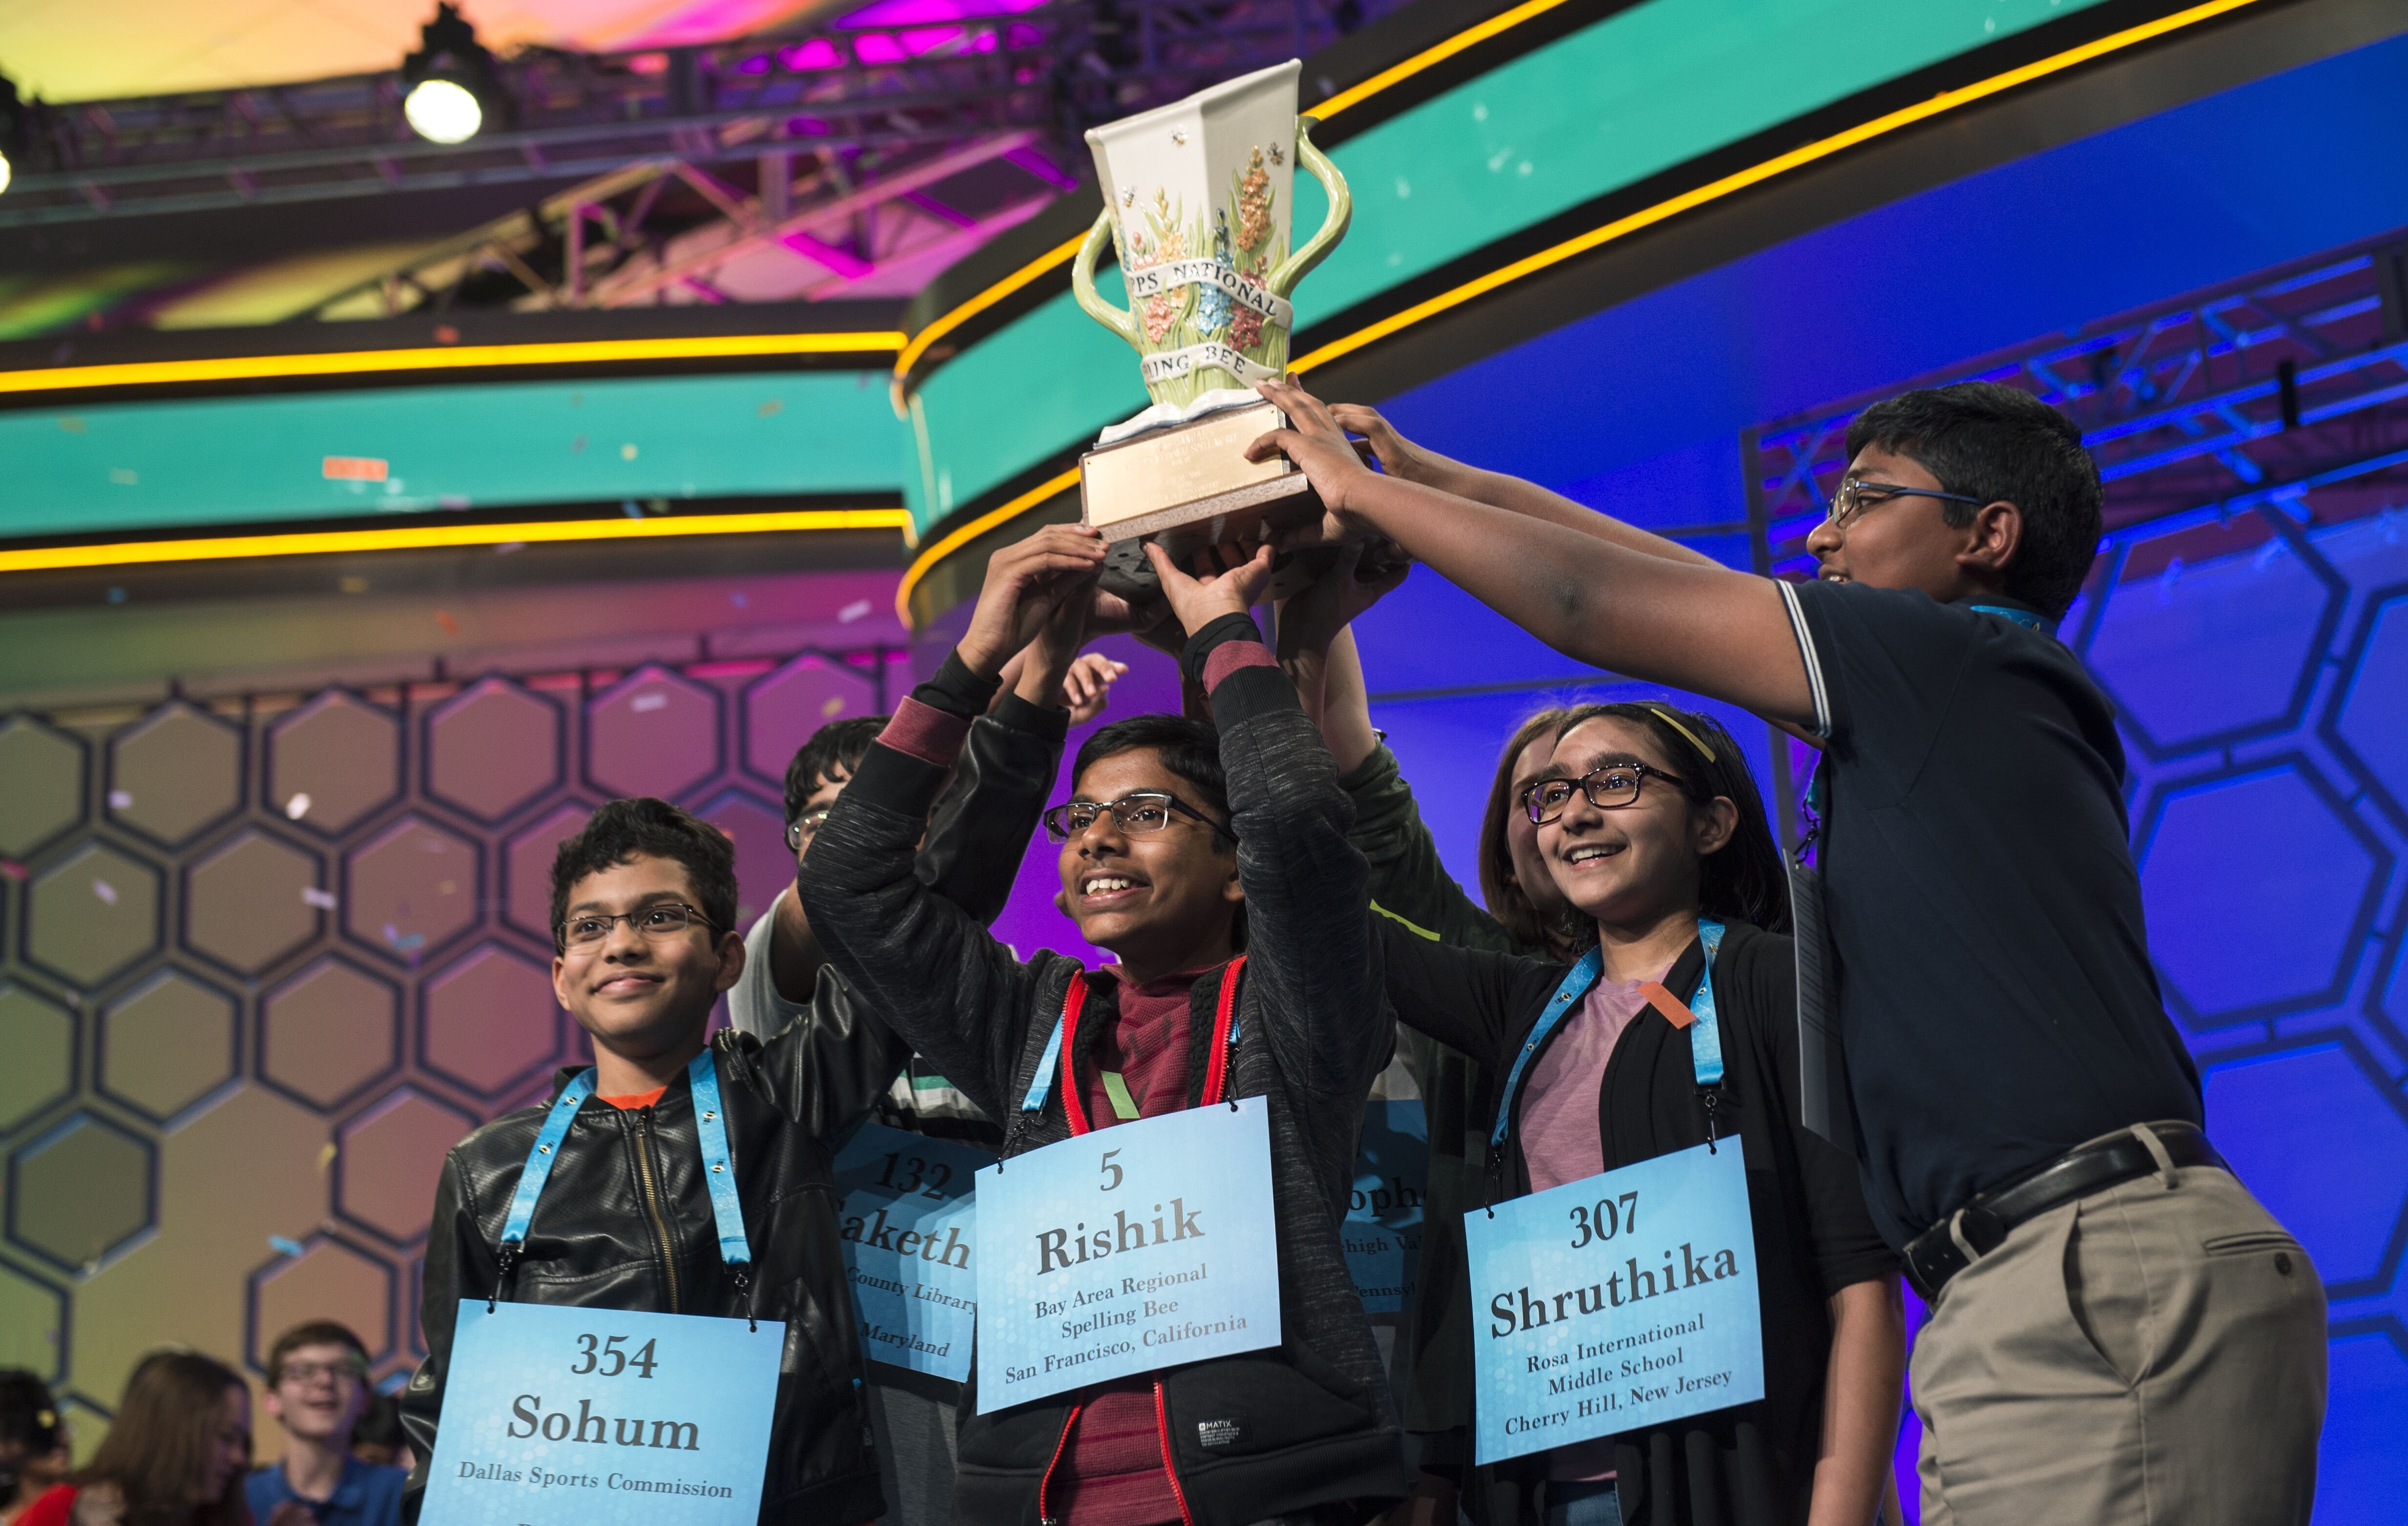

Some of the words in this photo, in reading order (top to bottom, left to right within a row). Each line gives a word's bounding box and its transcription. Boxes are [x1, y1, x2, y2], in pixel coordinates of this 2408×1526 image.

[1173, 263, 1276, 316] NATIONAL
[1205, 346, 1246, 374] BEE
[874, 1153, 952, 1200] 132
[1100, 1148, 1123, 1191] 5
[1350, 1176, 1426, 1217] oph
[1570, 1191, 1638, 1248] 307
[837, 1198, 970, 1270] aketh
[1036, 1198, 1205, 1275] Rishik
[847, 1267, 909, 1296] County
[913, 1283, 977, 1314] Library
[1035, 1301, 1067, 1319] Bay
[1073, 1288, 1114, 1308] Area
[1121, 1264, 1207, 1295] Regional
[1491, 1242, 1739, 1339] Shruthika
[860, 1322, 951, 1357] Maryland
[1062, 1310, 1136, 1339] Spelling
[1142, 1301, 1178, 1318] Bee
[1526, 1354, 1569, 1373] Rosa
[1577, 1314, 1704, 1360] International
[572, 1334, 658, 1378] 354
[1006, 1366, 1037, 1384] San
[1045, 1342, 1135, 1372] Francisco,
[1143, 1315, 1247, 1346] California
[1549, 1367, 1612, 1395] Middle
[1621, 1347, 1683, 1378] School
[508, 1395, 700, 1451] Sohum
[1206, 1420, 1232, 1429] MATIX
[1505, 1411, 1569, 1435] Cherry
[1578, 1393, 1622, 1418] Hill,
[1631, 1386, 1669, 1405] New
[1676, 1371, 1732, 1394] Jersey
[457, 1462, 522, 1482] Dallas
[529, 1467, 599, 1488] Sports
[608, 1473, 732, 1498] Commission
